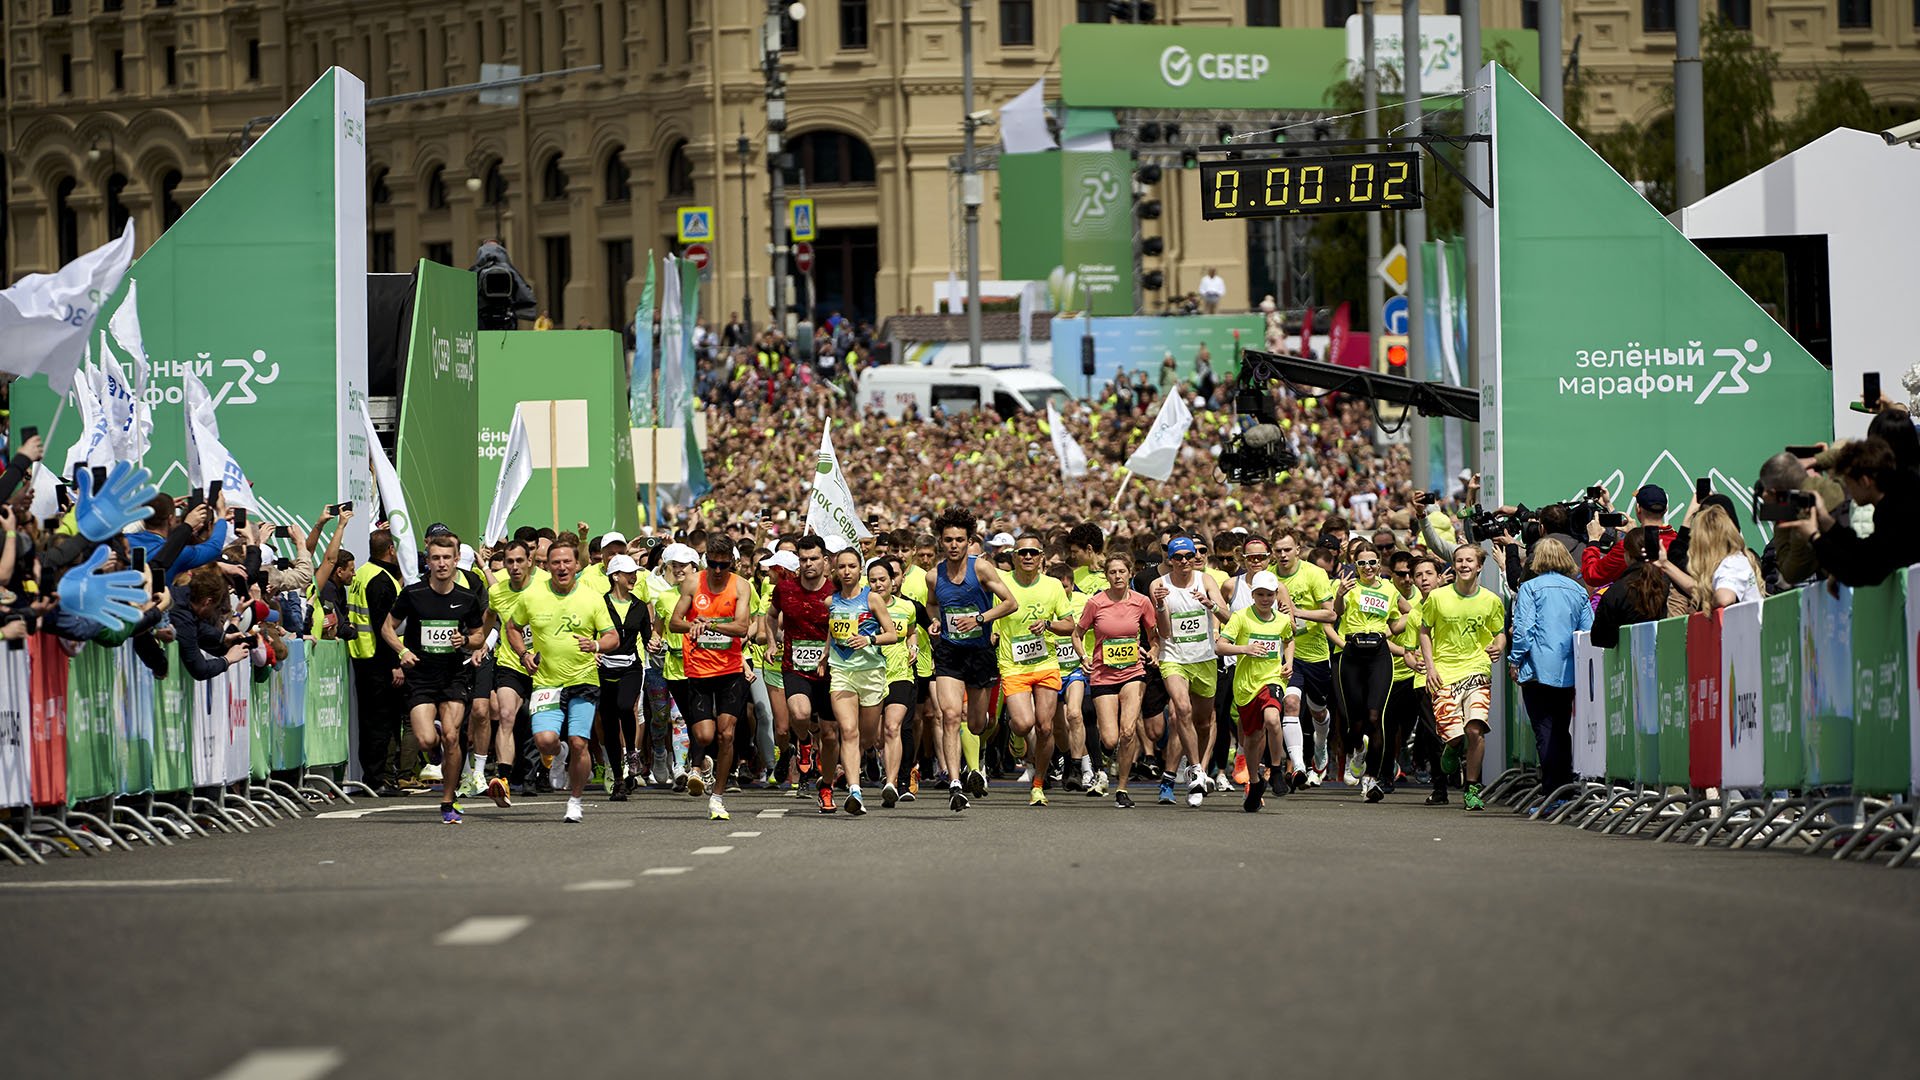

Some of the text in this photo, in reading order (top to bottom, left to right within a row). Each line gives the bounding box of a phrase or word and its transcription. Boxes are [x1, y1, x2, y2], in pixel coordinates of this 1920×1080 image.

[1197, 52, 1270, 80] СБЕР
[1575, 340, 1705, 368] зелёный
[1558, 368, 1694, 400] марафон
[833, 507, 862, 553] Серви
[1364, 596, 1385, 609] 9024
[833, 622, 850, 633] 879
[1180, 619, 1200, 631] 625
[427, 629, 454, 641] 1669
[1016, 640, 1043, 655] 3095
[1107, 646, 1134, 658] 3452
[796, 649, 823, 660] 2259
[538, 692, 550, 702] 20
